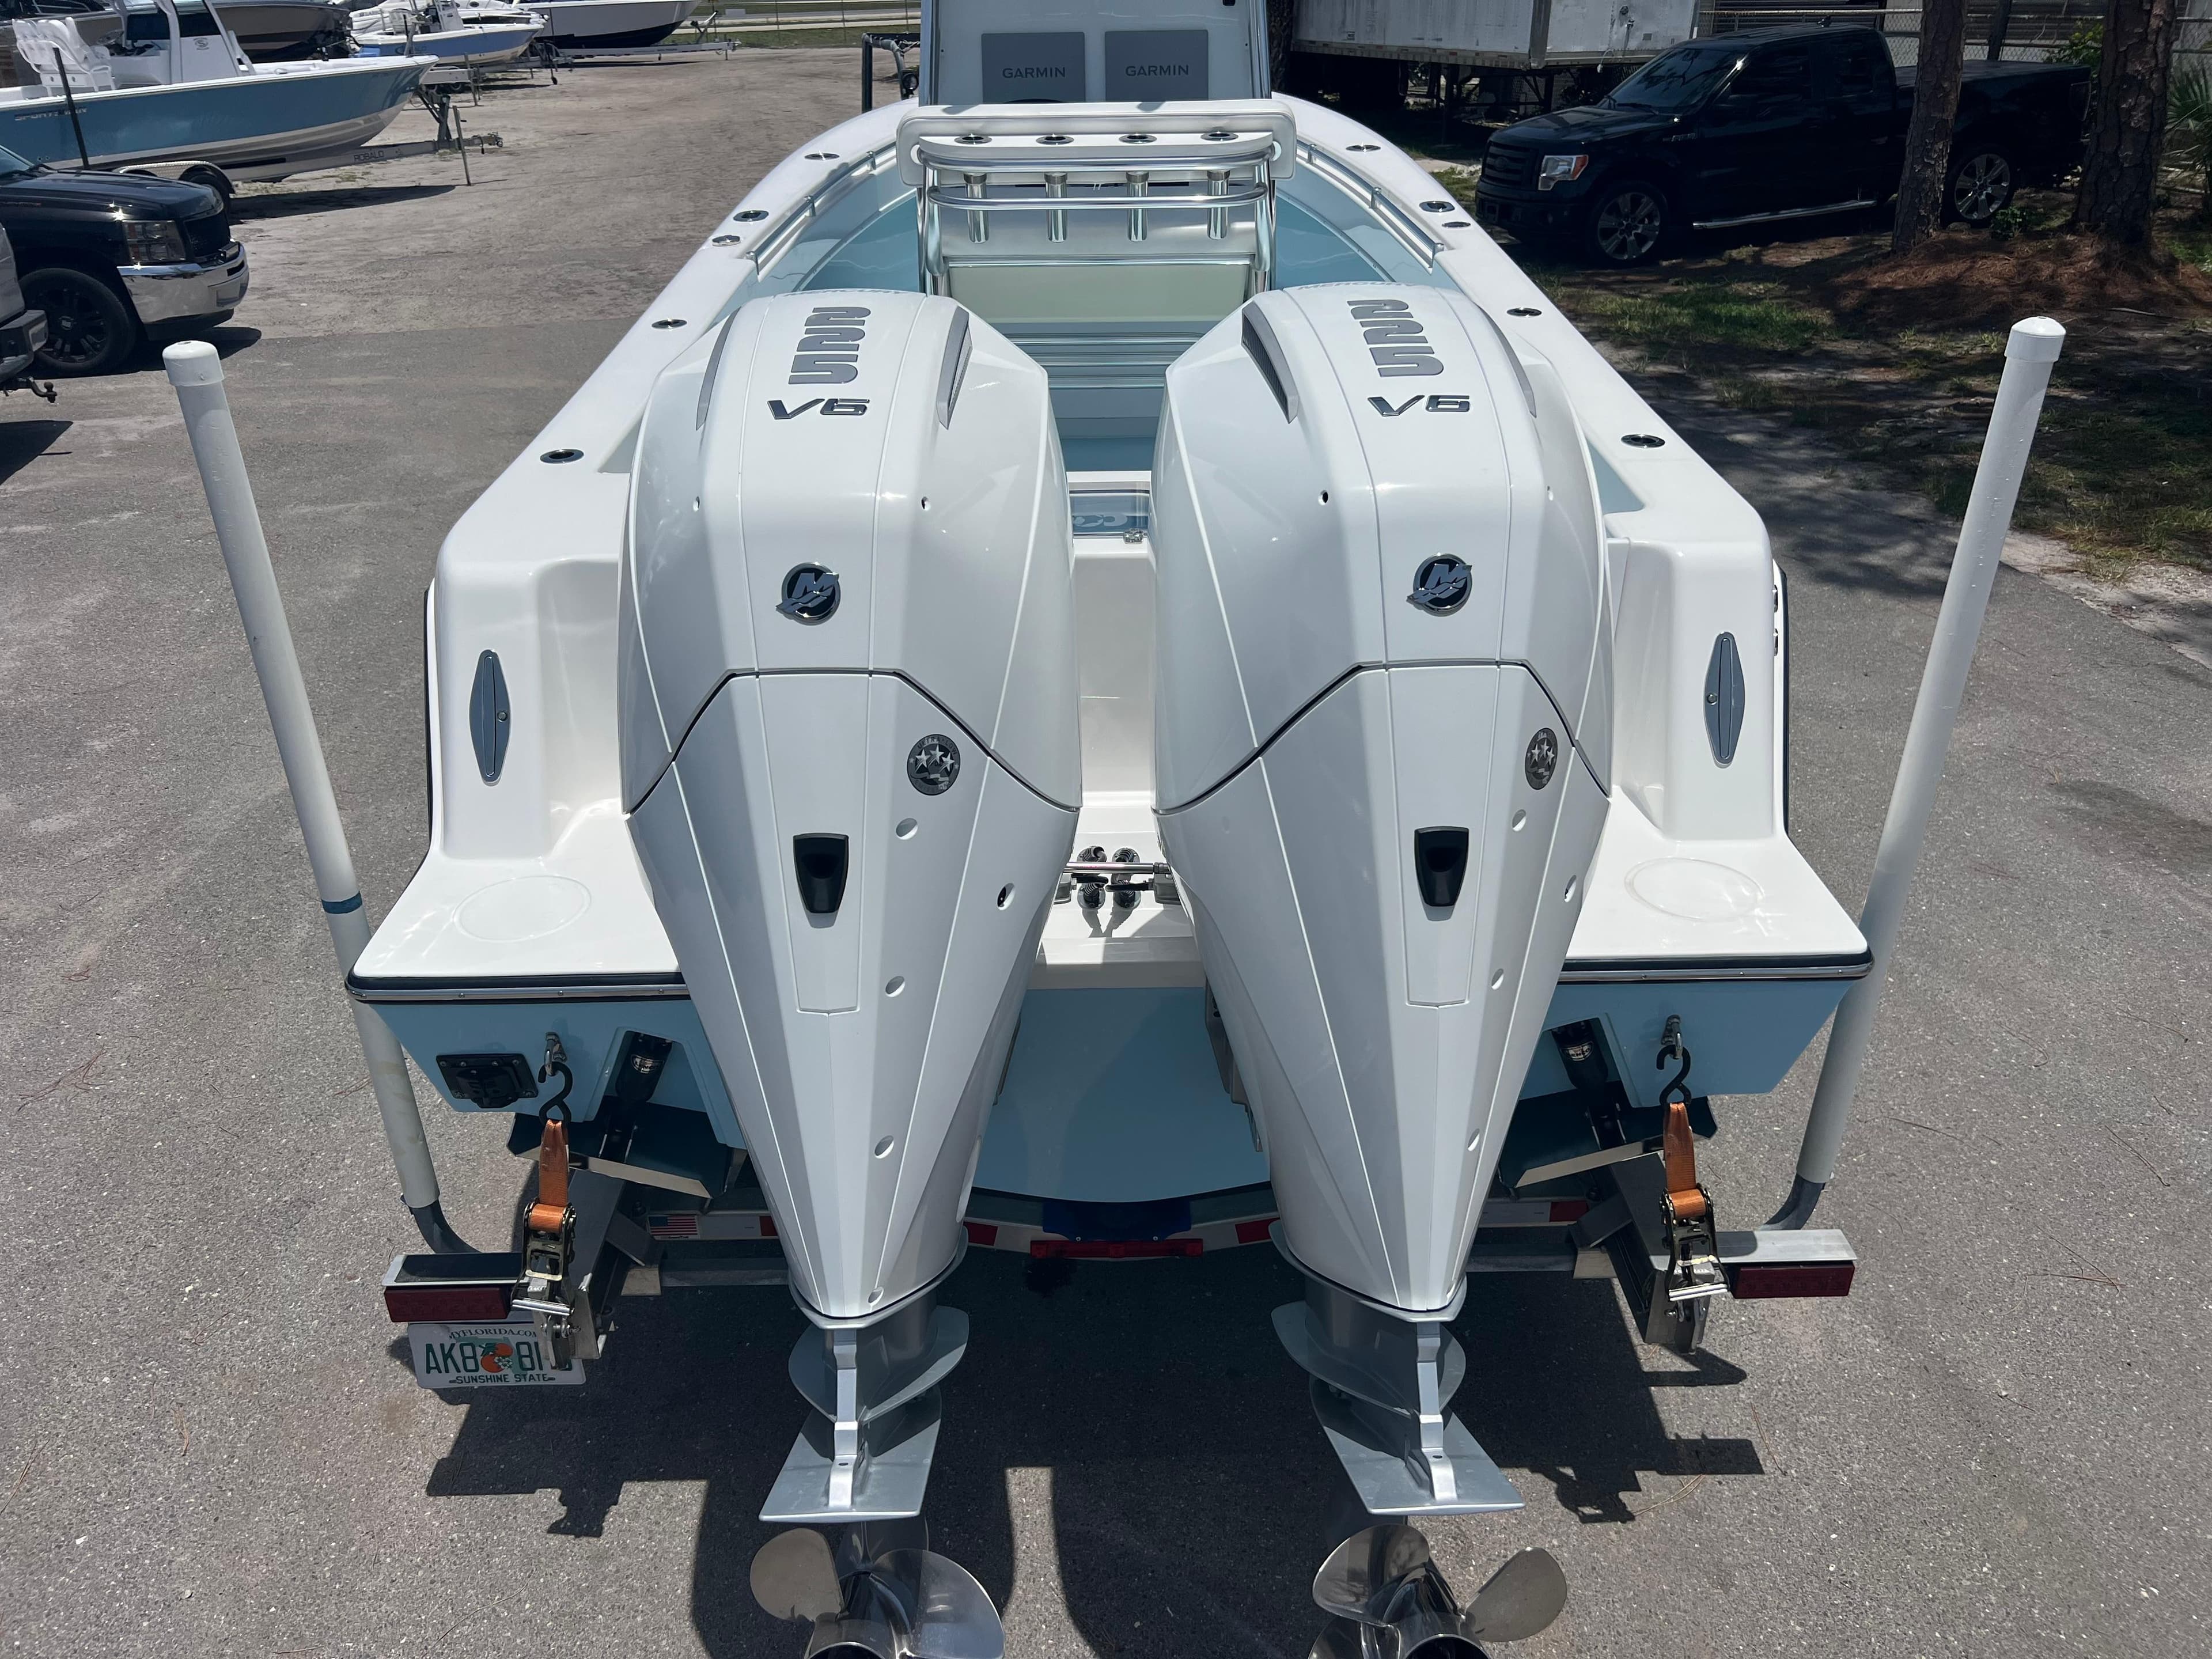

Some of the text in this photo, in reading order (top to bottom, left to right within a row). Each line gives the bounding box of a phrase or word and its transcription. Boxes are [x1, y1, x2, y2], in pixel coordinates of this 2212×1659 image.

[1002, 66, 1066, 79] GARMIN
[1125, 64, 1190, 77] GARMIN
[788, 306, 871, 384] 225
[1347, 299, 1444, 377] 225
[767, 398, 870, 419] V6
[1367, 395, 1470, 416] V6
[456, 1373, 548, 1384] SUNSHINE STATE
